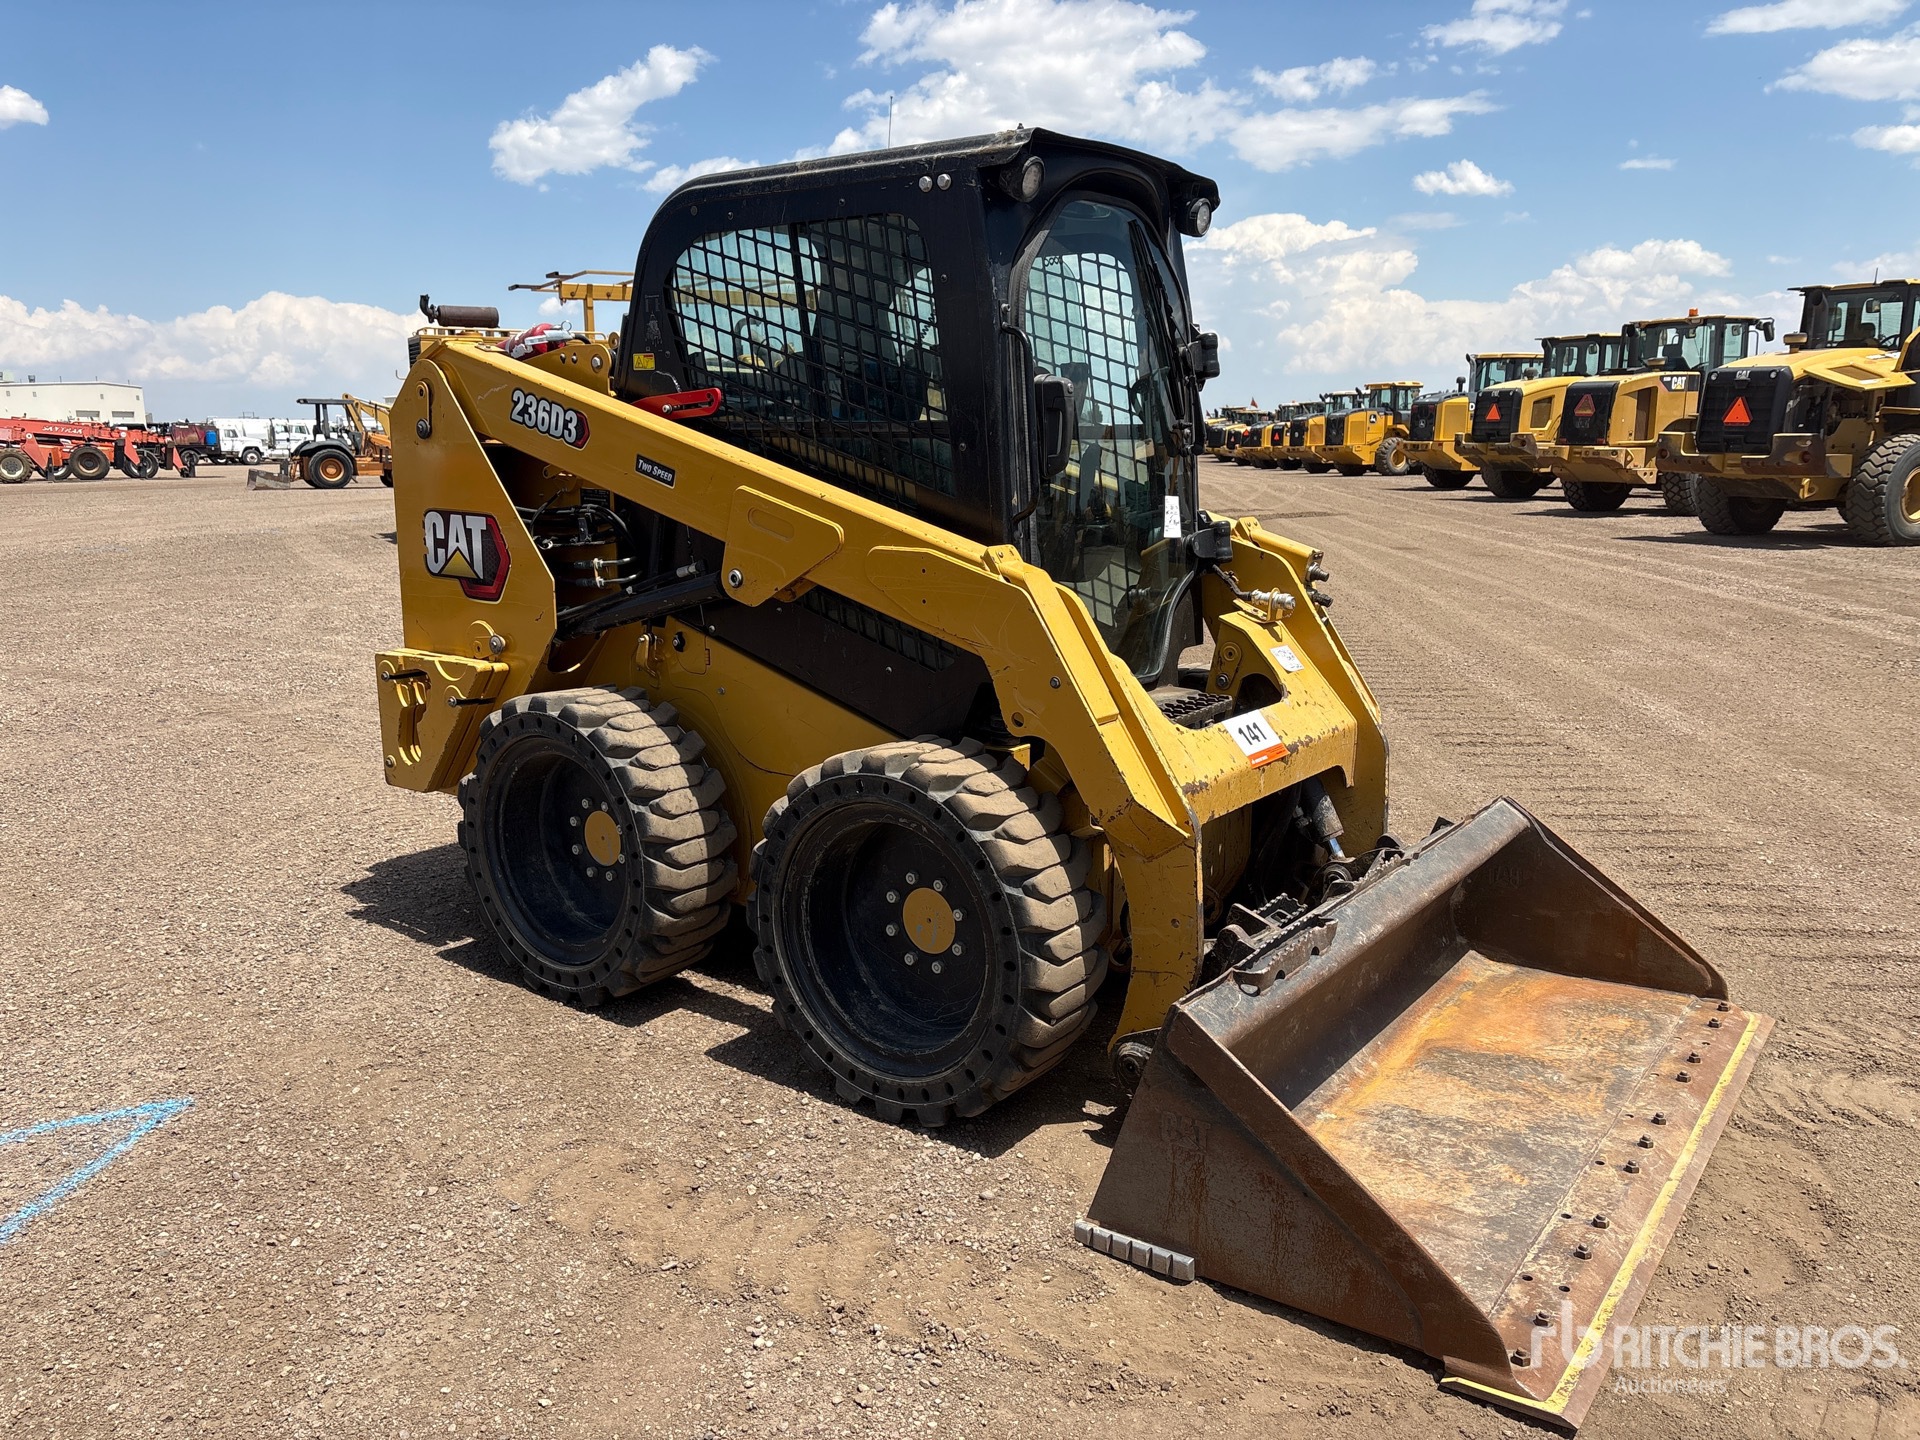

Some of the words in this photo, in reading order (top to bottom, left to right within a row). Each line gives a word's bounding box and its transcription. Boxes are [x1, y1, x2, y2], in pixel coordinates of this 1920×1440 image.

[1671, 376, 1687, 390] CAT
[511, 389, 578, 443] 236D3
[638, 459, 652, 473] TWO
[652, 466, 673, 481] SPEED
[424, 511, 487, 579] CAT
[1238, 722, 1267, 745] 141
